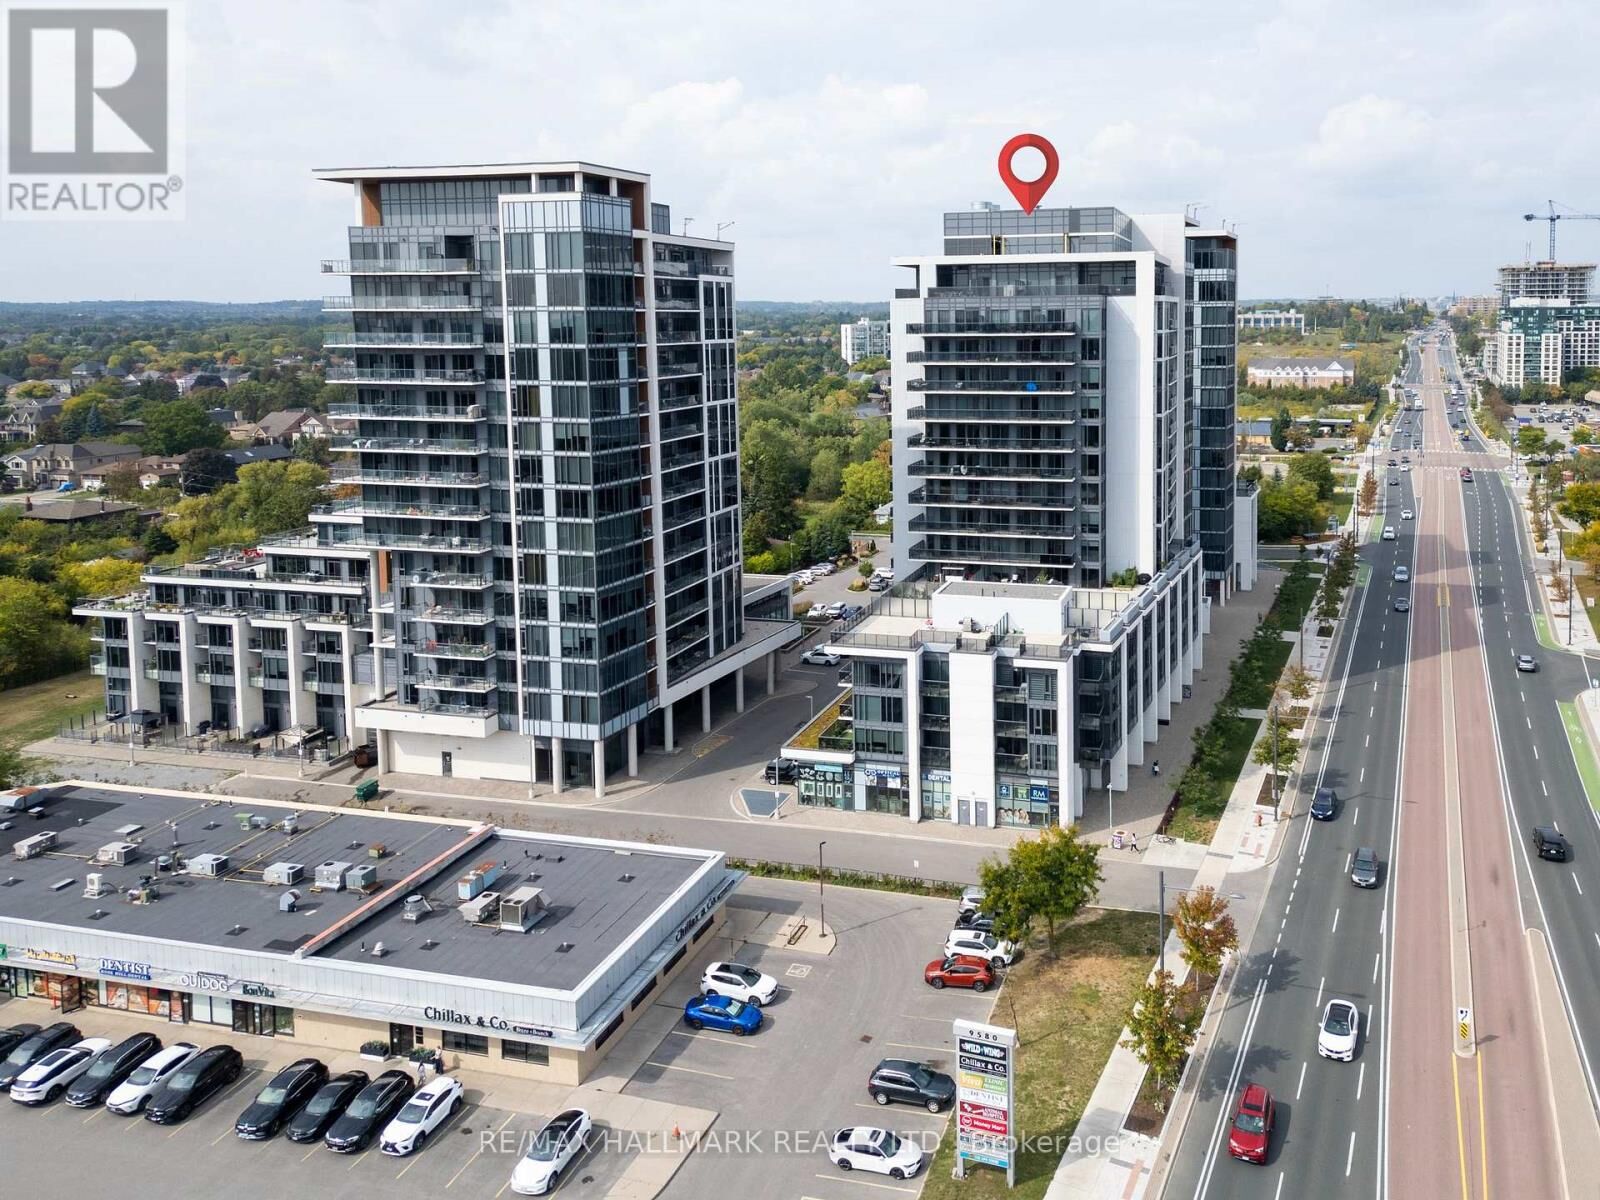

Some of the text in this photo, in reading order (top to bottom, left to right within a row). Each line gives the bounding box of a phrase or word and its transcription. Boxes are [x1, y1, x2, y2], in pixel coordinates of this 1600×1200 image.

[927, 774, 950, 782] DENTAL
[99, 958, 150, 976] DENTIST
[424, 1005, 472, 1026] Chillax
[476, 1015, 487, 1028] &
[969, 1029, 998, 1042] 9580
[966, 1042, 1001, 1058] WILD WING
[960, 1056, 985, 1069] Chillax
[987, 1062, 993, 1070] &
[994, 1063, 1006, 1073] Co.
[973, 1120, 991, 1130] Money
